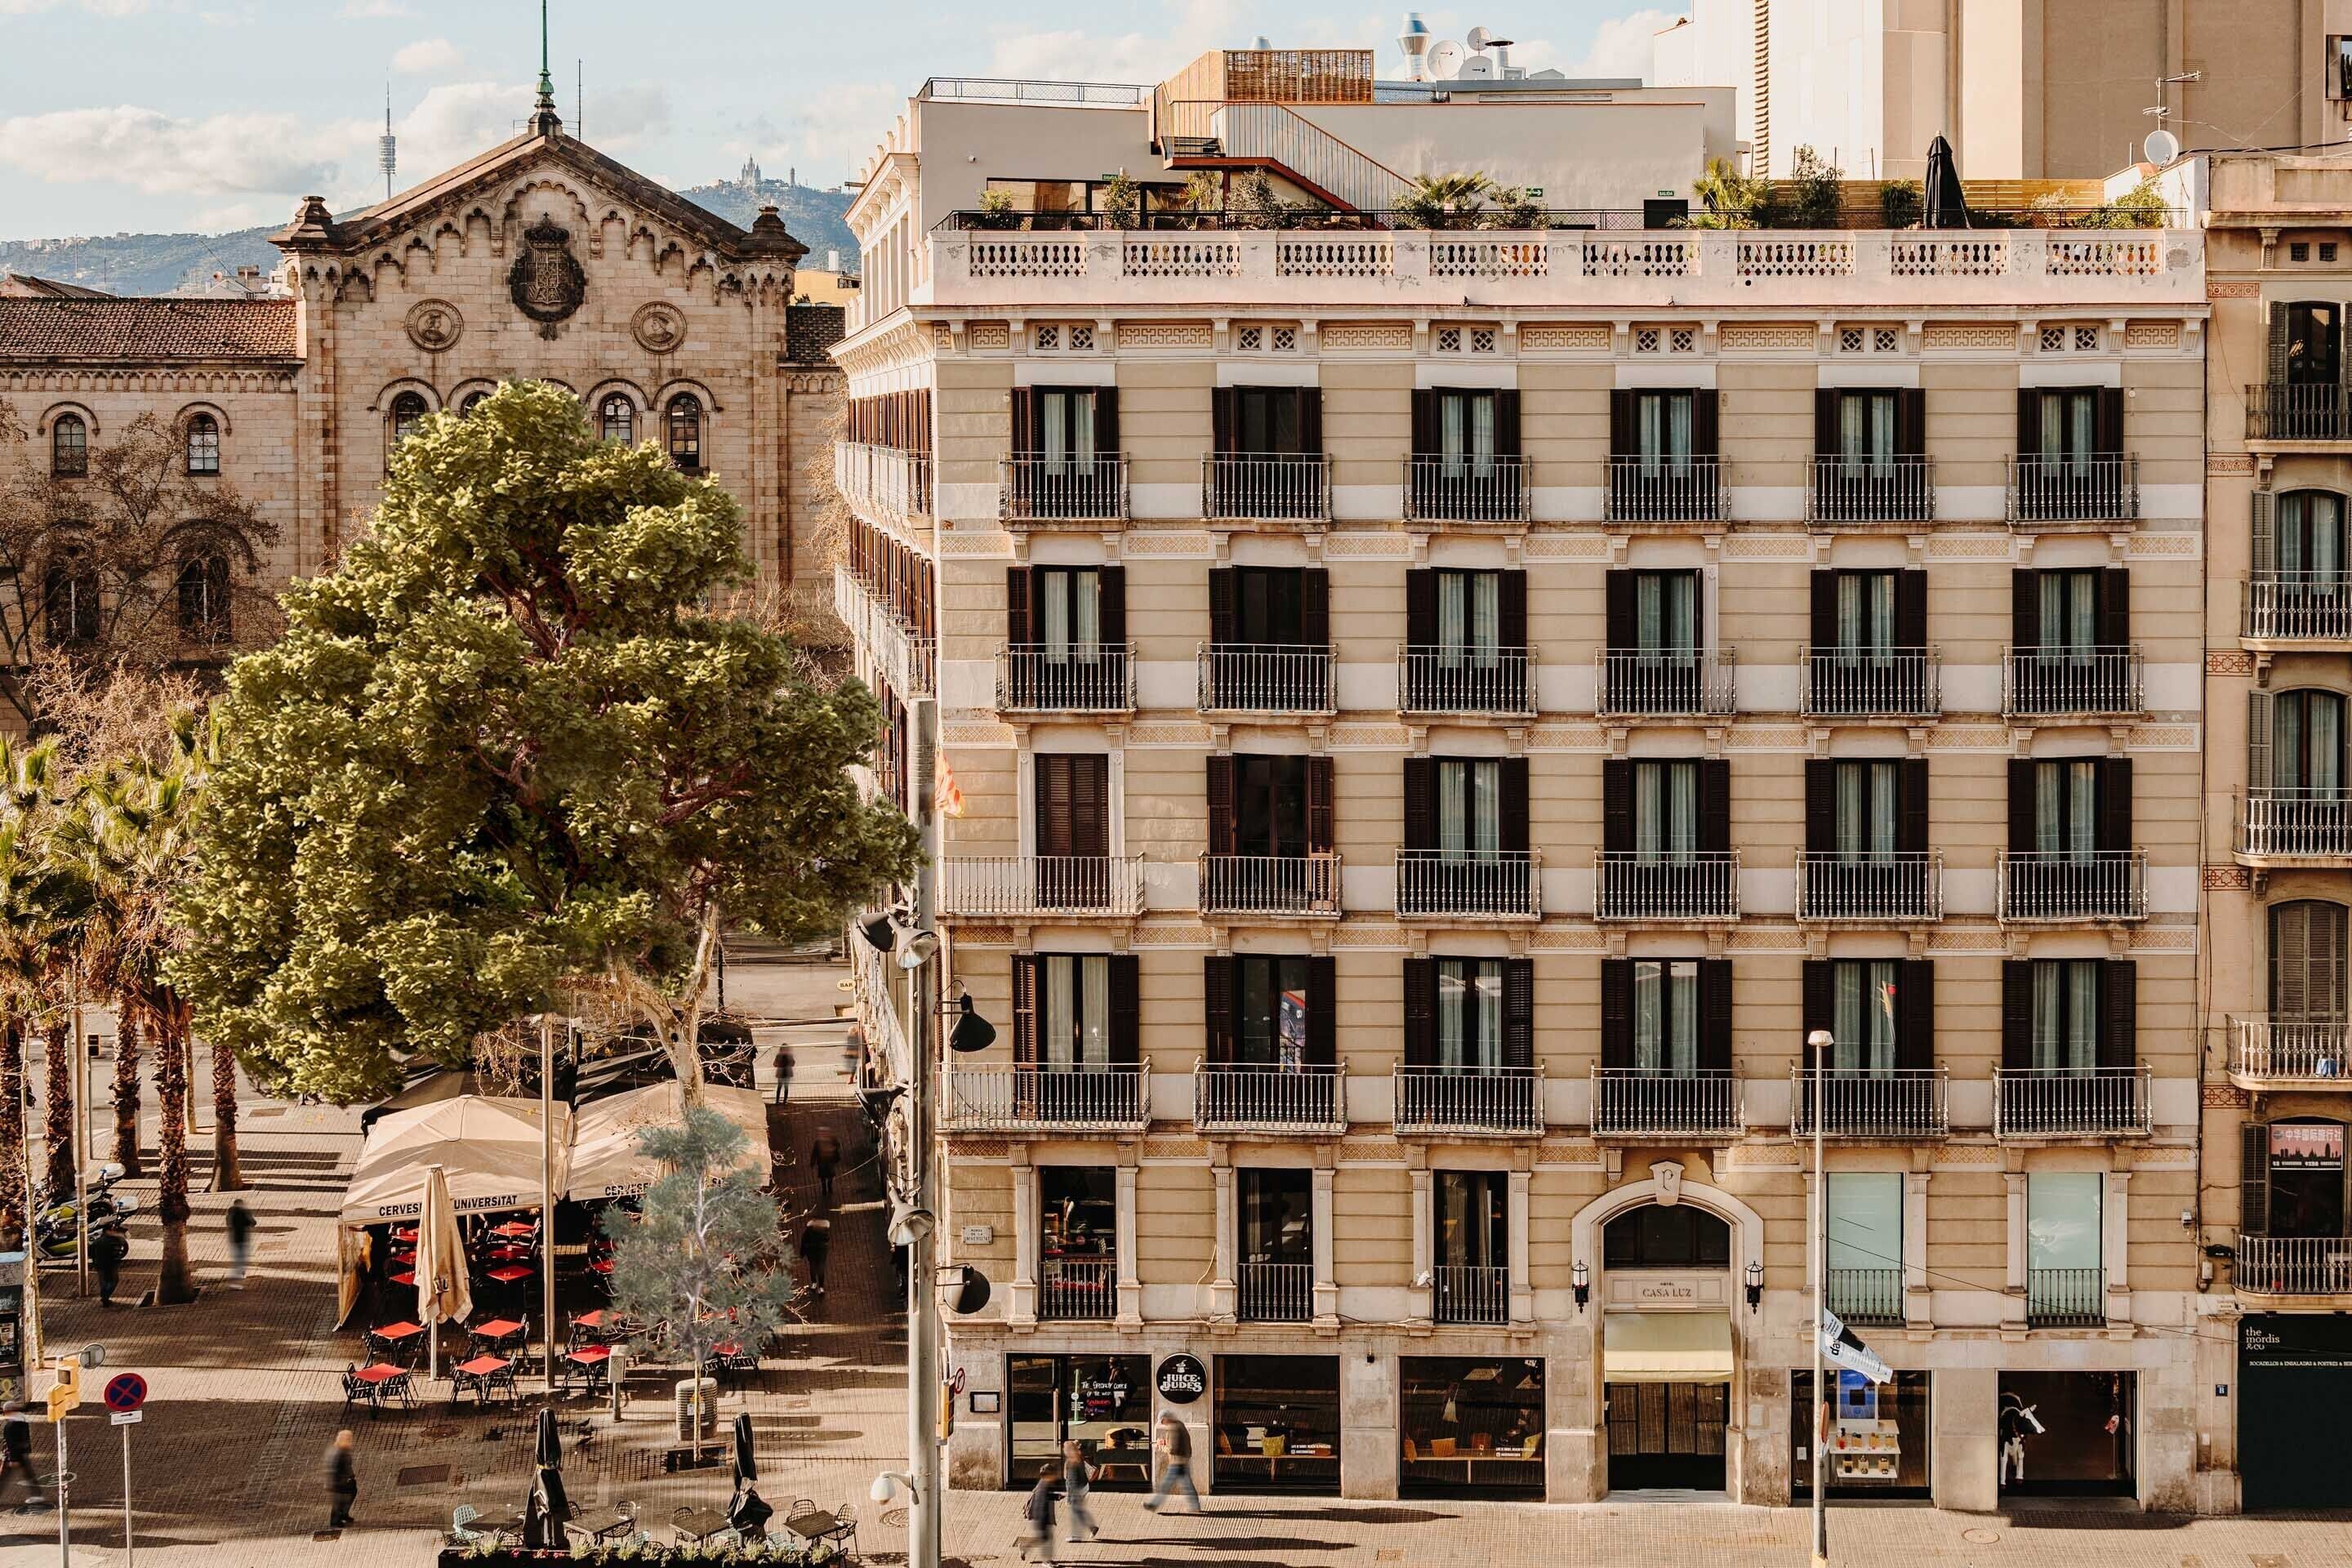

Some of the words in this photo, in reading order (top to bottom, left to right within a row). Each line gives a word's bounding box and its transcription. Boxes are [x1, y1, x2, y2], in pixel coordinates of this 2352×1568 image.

[454, 1195, 518, 1210] UNIVERSITAT
[1642, 1289, 1669, 1298] CASA
[1673, 1289, 1691, 1298] LUZ
[2246, 1326, 2262, 1336] the
[2246, 1334, 2280, 1343] mordis
[1167, 1374, 1197, 1383] JUICE
[1160, 1381, 1202, 1392] DUDES
